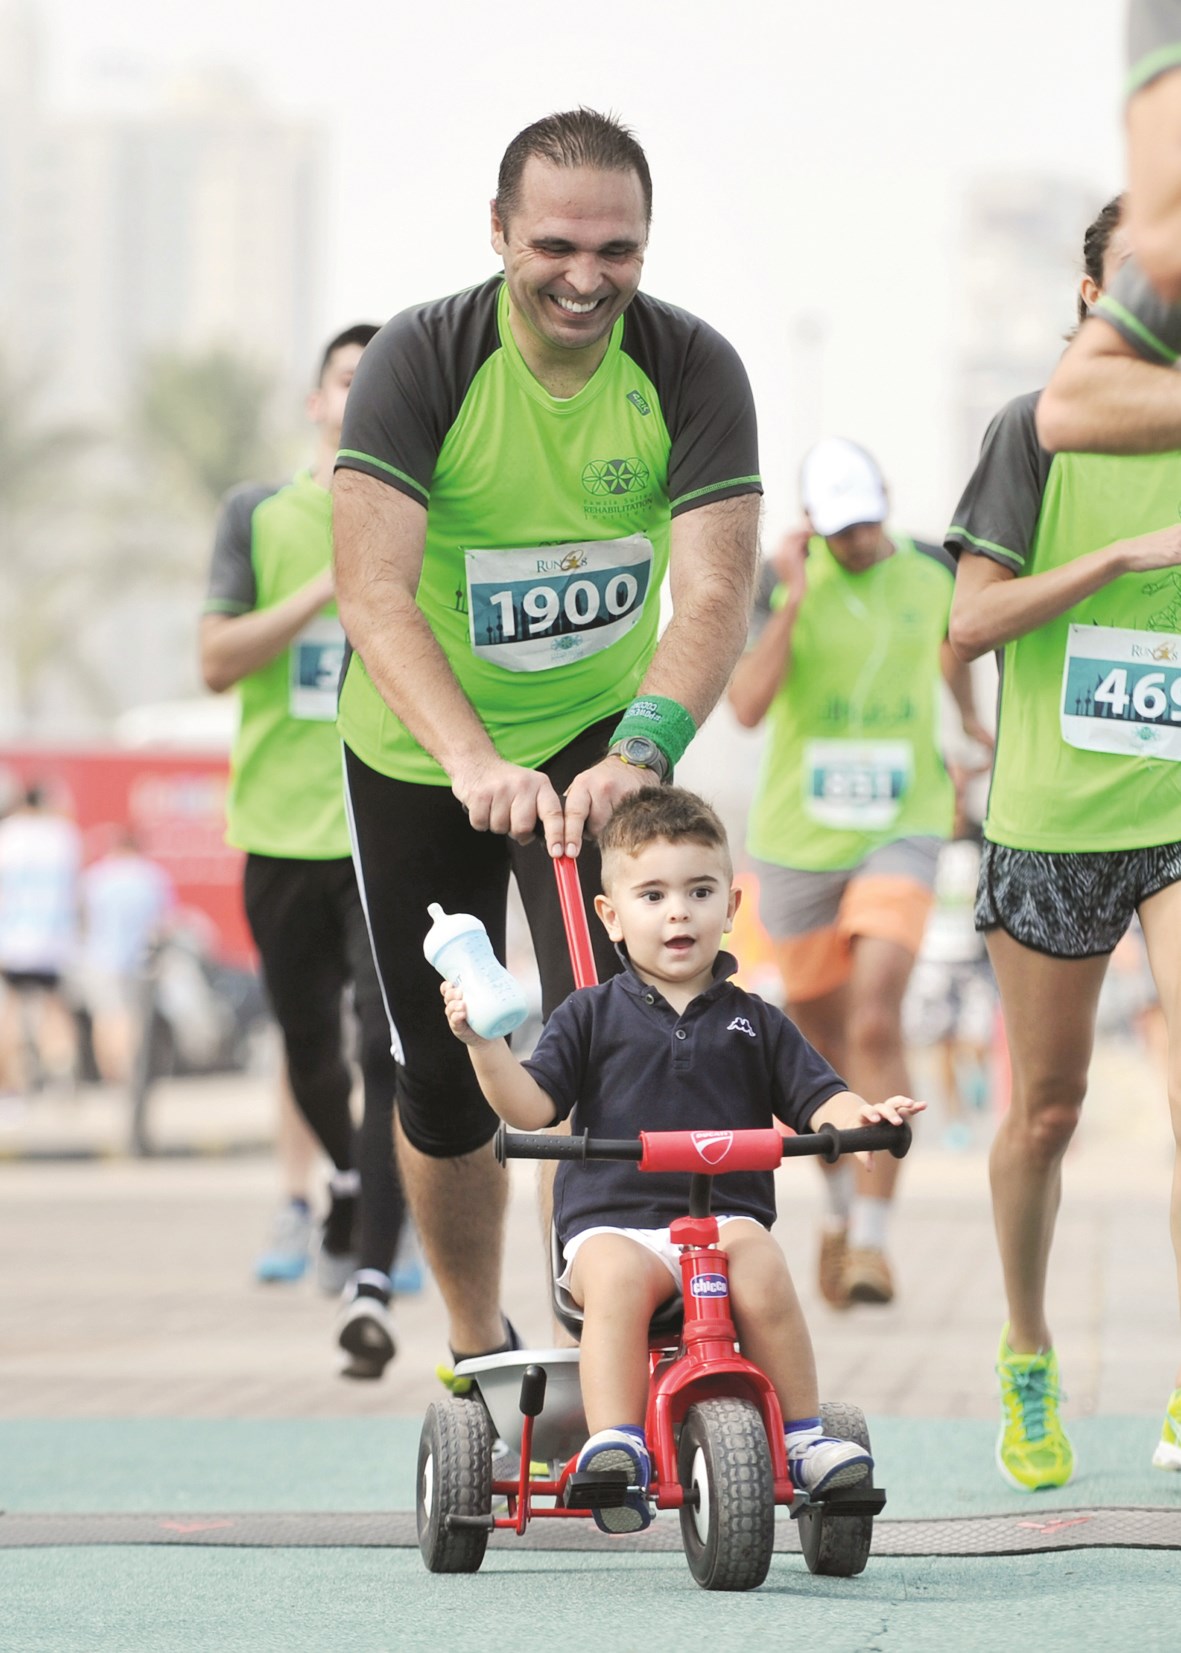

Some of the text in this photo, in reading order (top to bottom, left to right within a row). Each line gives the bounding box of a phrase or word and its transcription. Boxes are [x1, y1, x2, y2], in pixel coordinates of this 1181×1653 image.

[584, 498, 653, 514] REHABILITATION
[489, 573, 638, 637] 1900
[696, 1131, 728, 1139] DUCATI
[693, 1277, 727, 1293] chicco
